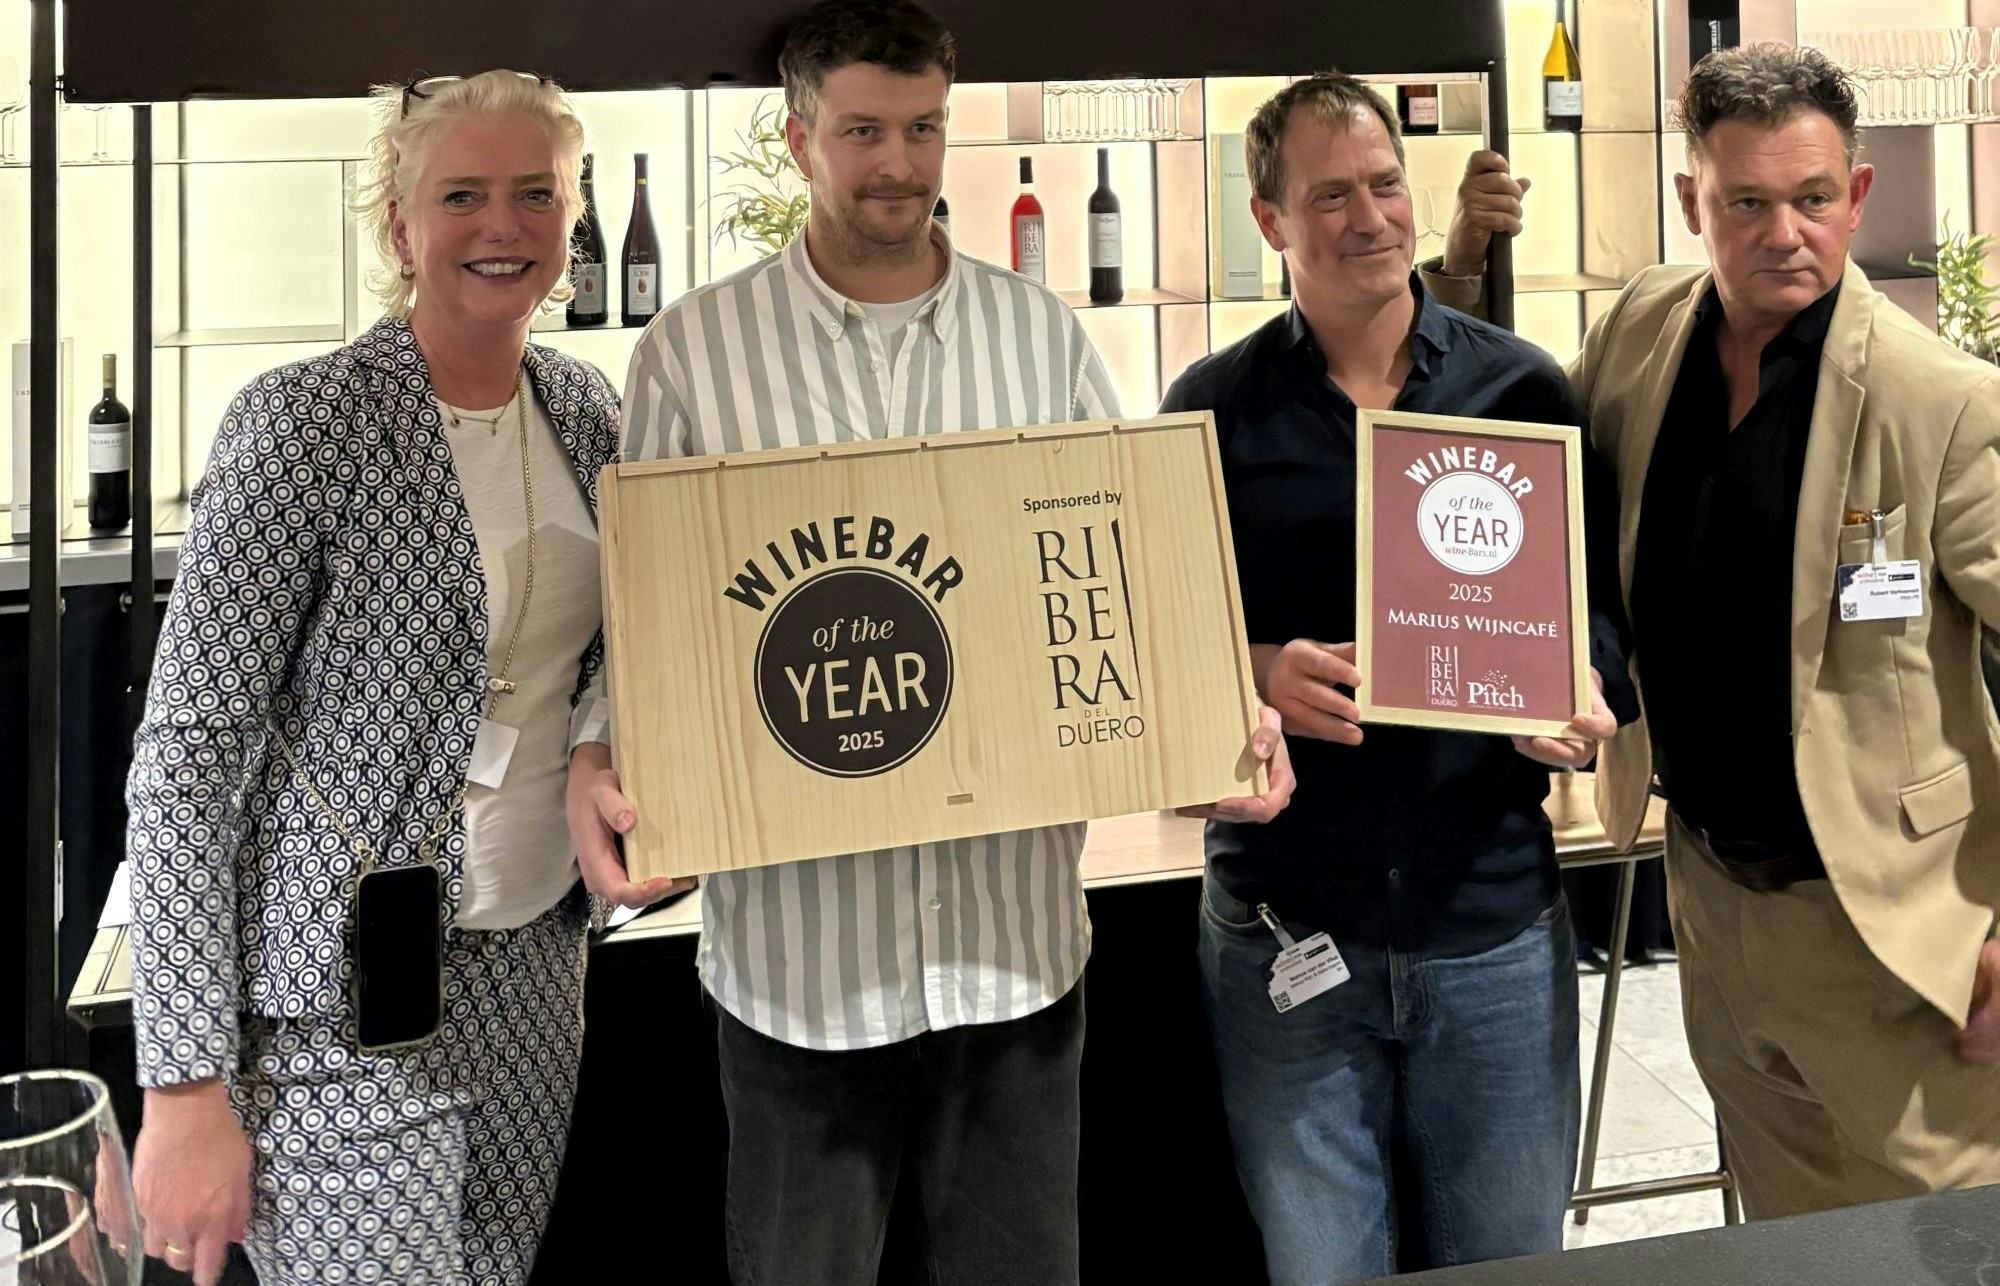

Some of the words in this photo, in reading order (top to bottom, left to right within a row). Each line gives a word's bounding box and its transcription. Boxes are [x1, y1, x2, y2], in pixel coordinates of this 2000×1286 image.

[1404, 446, 1533, 499] WINEBAR
[1023, 491, 1101, 514] Sponsored
[1105, 489, 1122, 506] by
[1449, 496, 1467, 511] of
[1469, 497, 1493, 511] the
[1434, 513, 1509, 547] YEAR
[724, 516, 964, 612] WINEBAR
[1032, 525, 1102, 584] RI
[1449, 583, 1493, 603] 2025
[1039, 586, 1116, 647] BE
[812, 618, 845, 652] of
[850, 616, 895, 643] the
[784, 652, 930, 723] YEAR
[1047, 649, 1136, 710] RA
[1467, 682, 1525, 708] Pitch
[1083, 708, 1110, 719] DEL
[838, 730, 885, 753] 2025
[1057, 715, 1145, 748] DUERO
